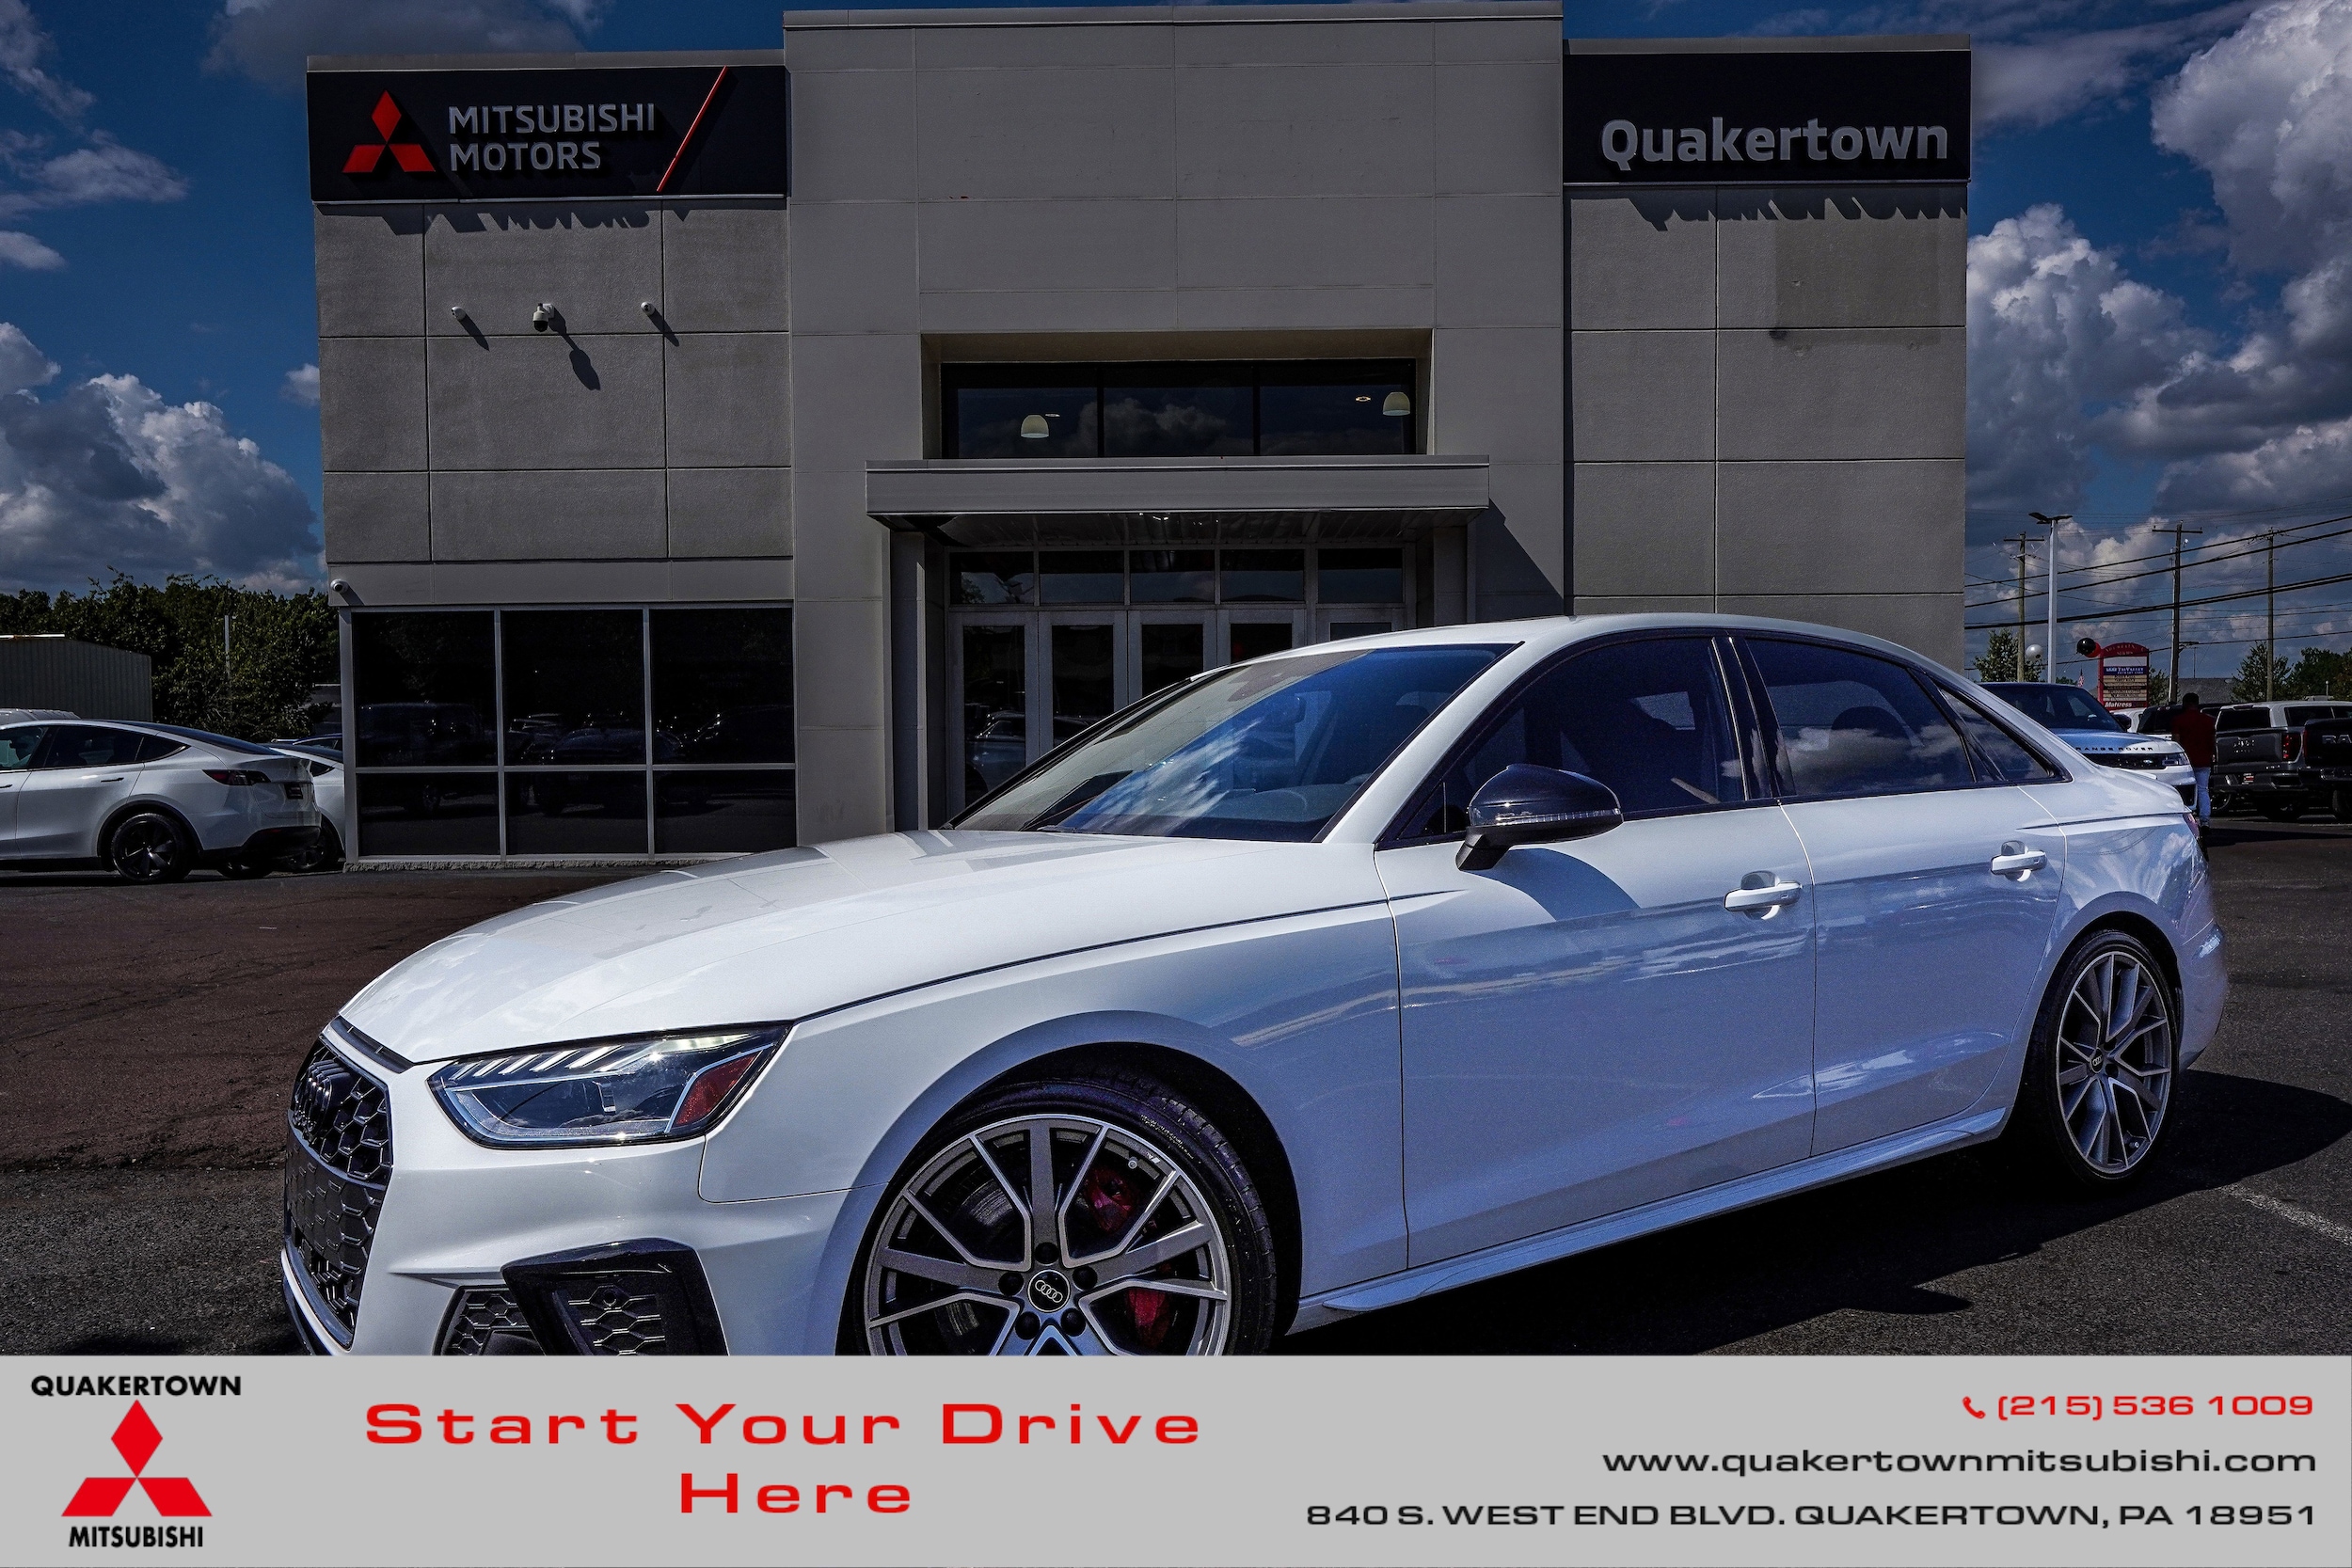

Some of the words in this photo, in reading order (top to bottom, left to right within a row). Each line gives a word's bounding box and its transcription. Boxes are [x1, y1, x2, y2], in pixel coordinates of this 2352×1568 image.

[448, 103, 656, 135] MITSUBISHI
[450, 140, 602, 172] MOTORS
[1601, 116, 1948, 171] Quakertown
